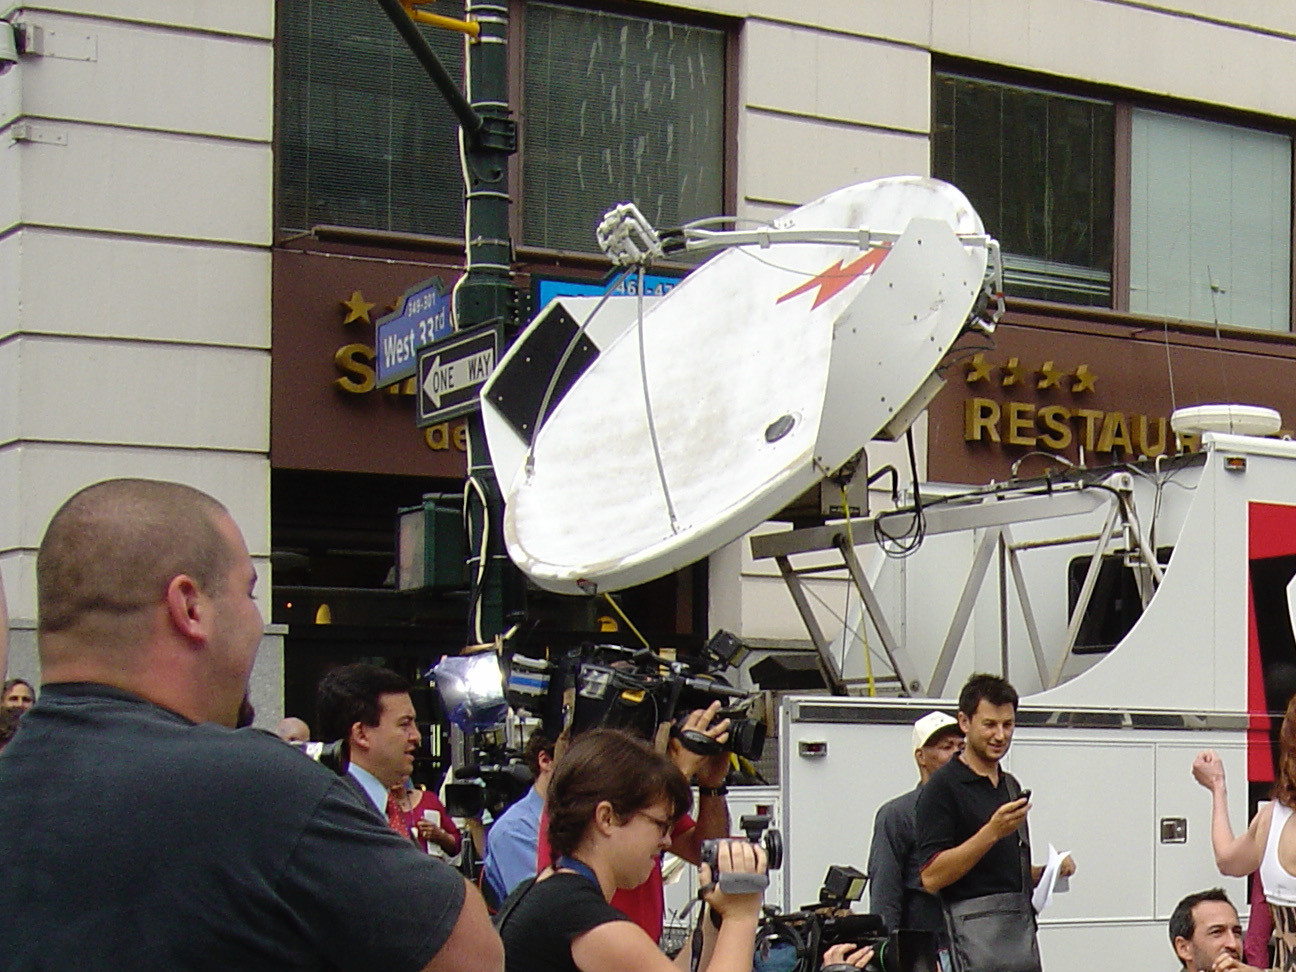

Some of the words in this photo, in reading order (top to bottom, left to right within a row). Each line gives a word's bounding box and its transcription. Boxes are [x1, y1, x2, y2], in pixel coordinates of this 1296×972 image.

[383, 329, 415, 368] West
[419, 307, 446, 343] 33rd
[432, 367, 454, 393] ONE
[467, 351, 491, 380] WAY
